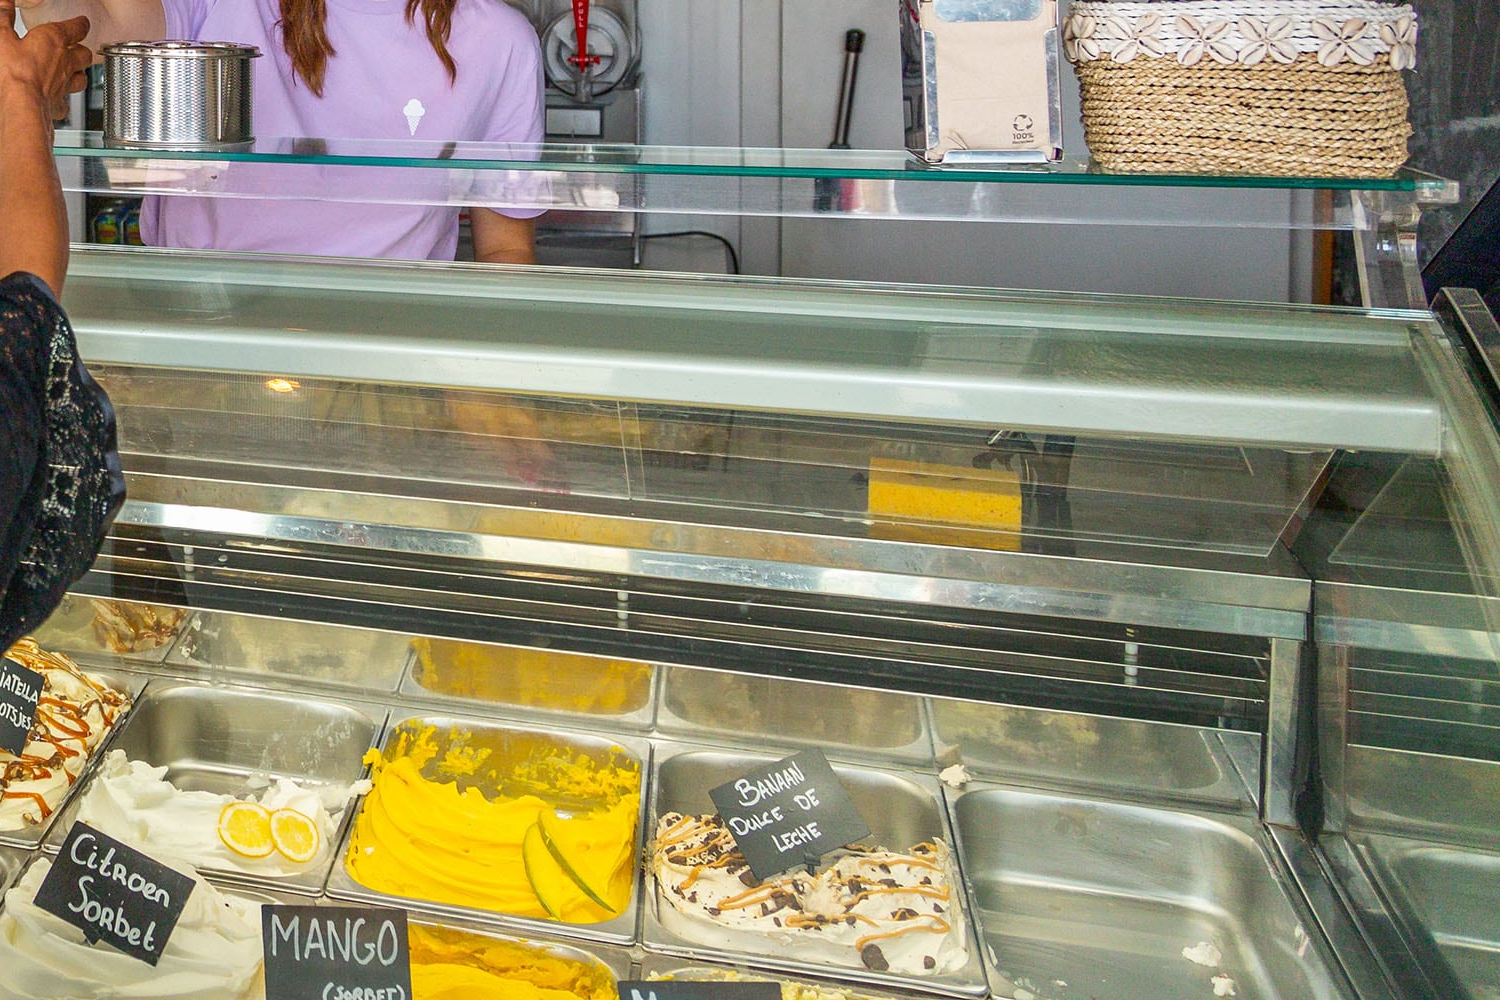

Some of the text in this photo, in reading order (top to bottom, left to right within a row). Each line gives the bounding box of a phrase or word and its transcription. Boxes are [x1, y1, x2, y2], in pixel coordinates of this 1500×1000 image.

[734, 760, 805, 807] BANAAN
[729, 788, 820, 836] DULCE DE
[771, 822, 822, 853] LECHE
[271, 914, 399, 967] MANGO
